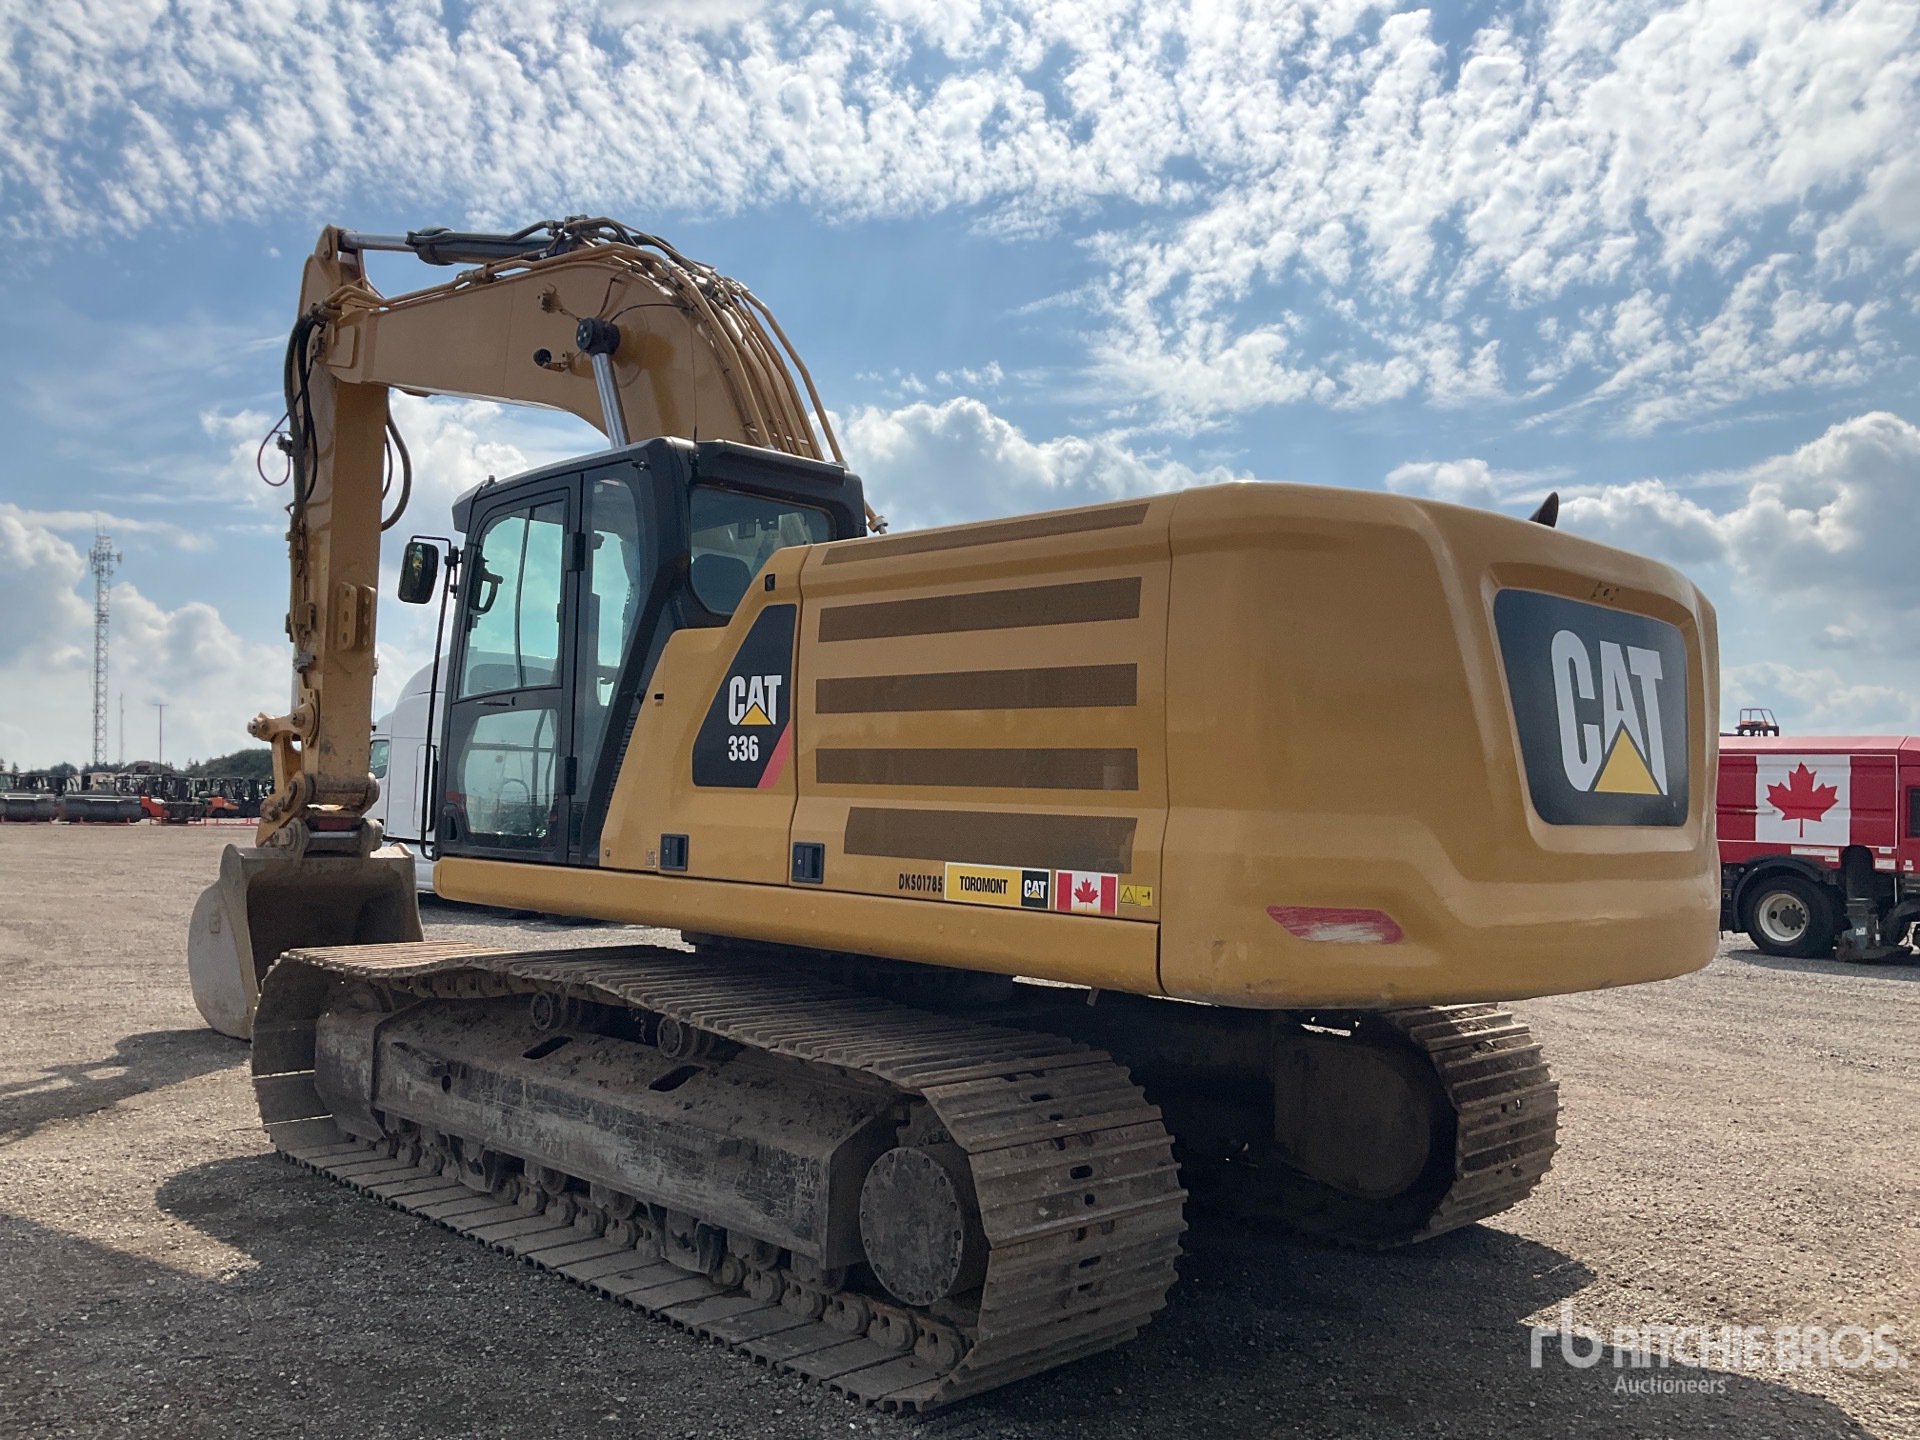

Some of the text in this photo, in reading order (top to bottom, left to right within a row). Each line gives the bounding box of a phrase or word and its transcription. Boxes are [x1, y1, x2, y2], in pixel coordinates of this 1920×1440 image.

[728, 675, 782, 726] CAT
[1551, 629, 1668, 796] CAT
[728, 735, 759, 762] 336
[899, 873, 943, 893] DKS01785
[959, 875, 1008, 895] TOROMONT
[1023, 879, 1047, 899] CAT
